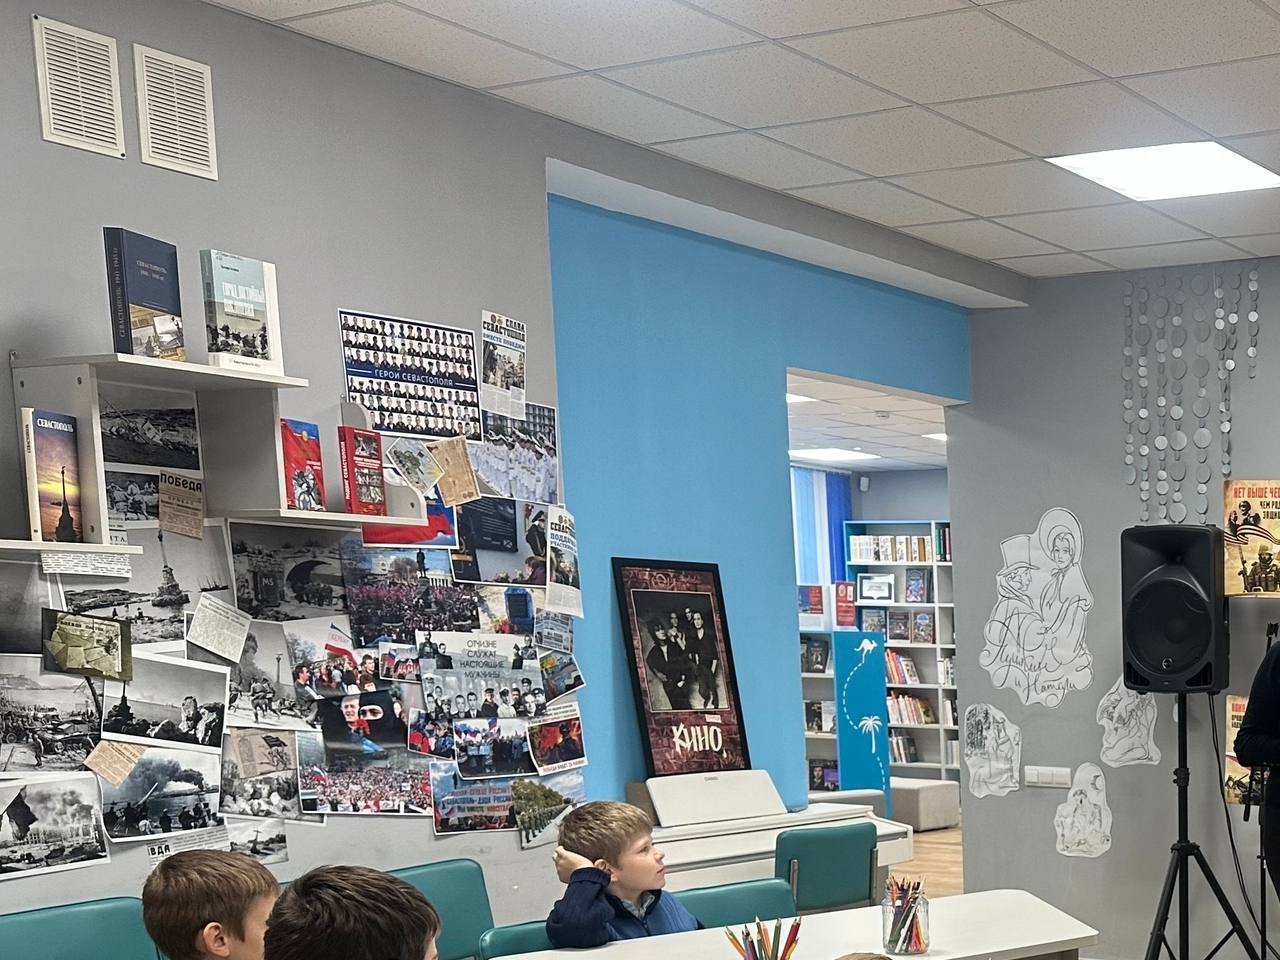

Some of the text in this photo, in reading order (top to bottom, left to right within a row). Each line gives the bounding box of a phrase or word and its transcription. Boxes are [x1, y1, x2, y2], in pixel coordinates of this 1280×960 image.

[374, 369, 453, 387] ГЕРОИ СЕВАСТОПОЛЯ
[36, 418, 74, 434] СЕВАСТОПОЛЬ
[340, 441, 349, 479] СЕВАСТОПОЛЯ
[1233, 486, 1246, 499] НЕТ
[1247, 486, 1268, 499] ВЫШЕ
[1259, 500, 1271, 510] ЧЕМ
[466, 640, 497, 648] ОТЧИЗНЕ
[467, 650, 497, 658] СЛУЖАТ
[460, 660, 504, 669] НАСТОЯЩИЕ
[464, 671, 500, 679] МУЖЧИНЫ
[672, 722, 723, 755] КИНО
